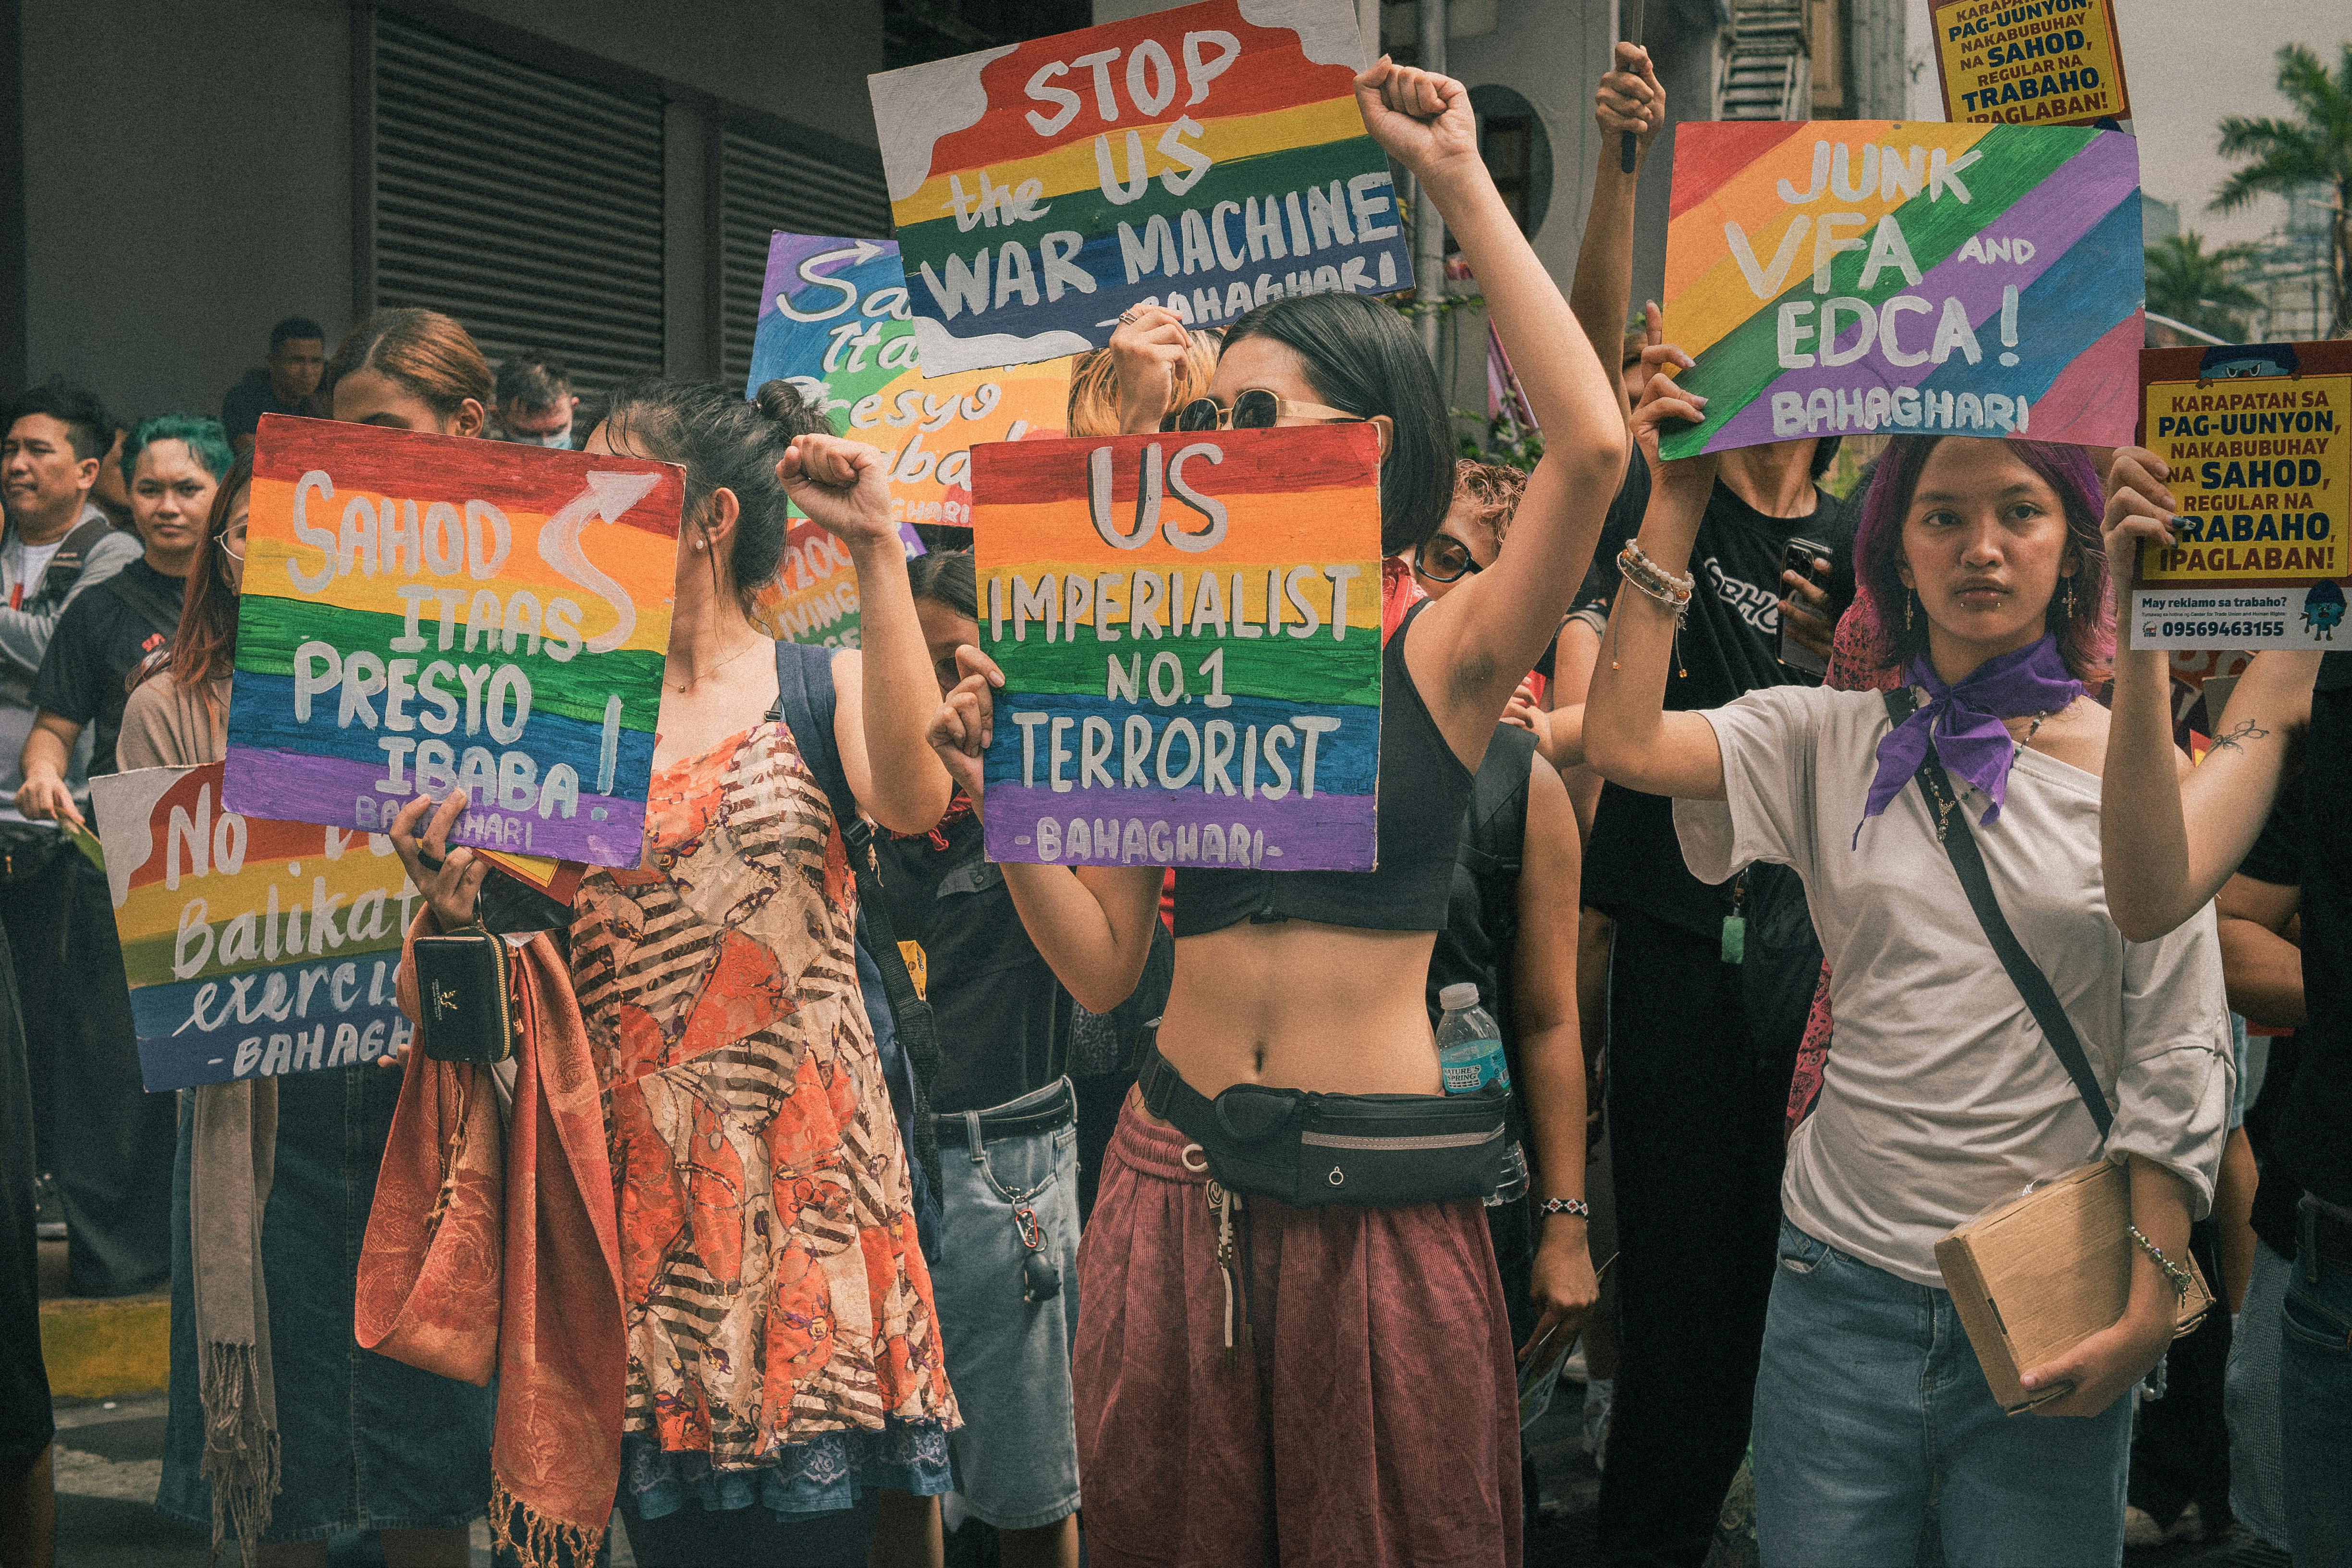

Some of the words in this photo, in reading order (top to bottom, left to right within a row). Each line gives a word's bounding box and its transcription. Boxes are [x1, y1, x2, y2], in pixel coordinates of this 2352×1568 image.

[1948, 0, 2094, 42] PAG-UUNYON,
[1956, 0, 2037, 23] KARAPA
[1961, 12, 2085, 53] NAKABUBUHAY
[1960, 55, 1984, 71] NA
[1987, 29, 2092, 68] SAHOD,
[1978, 60, 2054, 87] REGULAR
[2058, 54, 2083, 70] NA
[1026, 31, 1241, 136] STOP
[1961, 67, 2105, 112] TRABAHO,
[941, 171, 1051, 233] the
[1095, 115, 1213, 205] US
[1777, 140, 1982, 204] JUNK
[920, 231, 1097, 321] WAR
[1118, 171, 1398, 285] MACHINE
[1724, 212, 1922, 299] VFA
[1958, 236, 2036, 266] AND
[776, 241, 912, 322] Sa
[1096, 250, 1397, 327] -AHAGHARI
[821, 321, 921, 373] Ita
[1772, 386, 2029, 437] BAHAGHARI
[2159, 411, 2341, 437] PAG-UUNYON,
[2171, 392, 2297, 413] KARAPATAN
[2301, 391, 2329, 407] SA
[2171, 438, 2328, 459] NAKABUBUHAY
[1089, 442, 1228, 552] US
[2167, 466, 2195, 483] NA
[2201, 459, 2331, 490] SAHOD,
[892, 498, 969, 524] GHARI
[2178, 512, 2335, 543] RABAHO,
[2184, 494, 2279, 512] REGULAR
[2284, 492, 2314, 509] NA
[287, 470, 511, 593] SAHOD
[2160, 547, 2334, 572] IPAGLABAN!
[390, 584, 583, 662] ITAAS
[989, 565, 1361, 642] IMPERIALIST
[2142, 598, 2166, 610] May
[2168, 597, 2216, 608] reklamo
[2218, 599, 2231, 608] sa
[2234, 597, 2287, 608] trabaho?
[2162, 621, 2284, 637] 09569463155
[294, 641, 531, 744] PRESYO
[1013, 712, 1341, 800] TERRORIST
[166, 783, 248, 892] No
[356, 796, 532, 851] BAHARI
[174, 874, 421, 981] Balikat
[172, 961, 401, 1037] exerci
[208, 1016, 414, 1078] -BAHAGH
[1444, 1066, 1480, 1075] NATURE'S
[1447, 1073, 1477, 1081] SPRING
